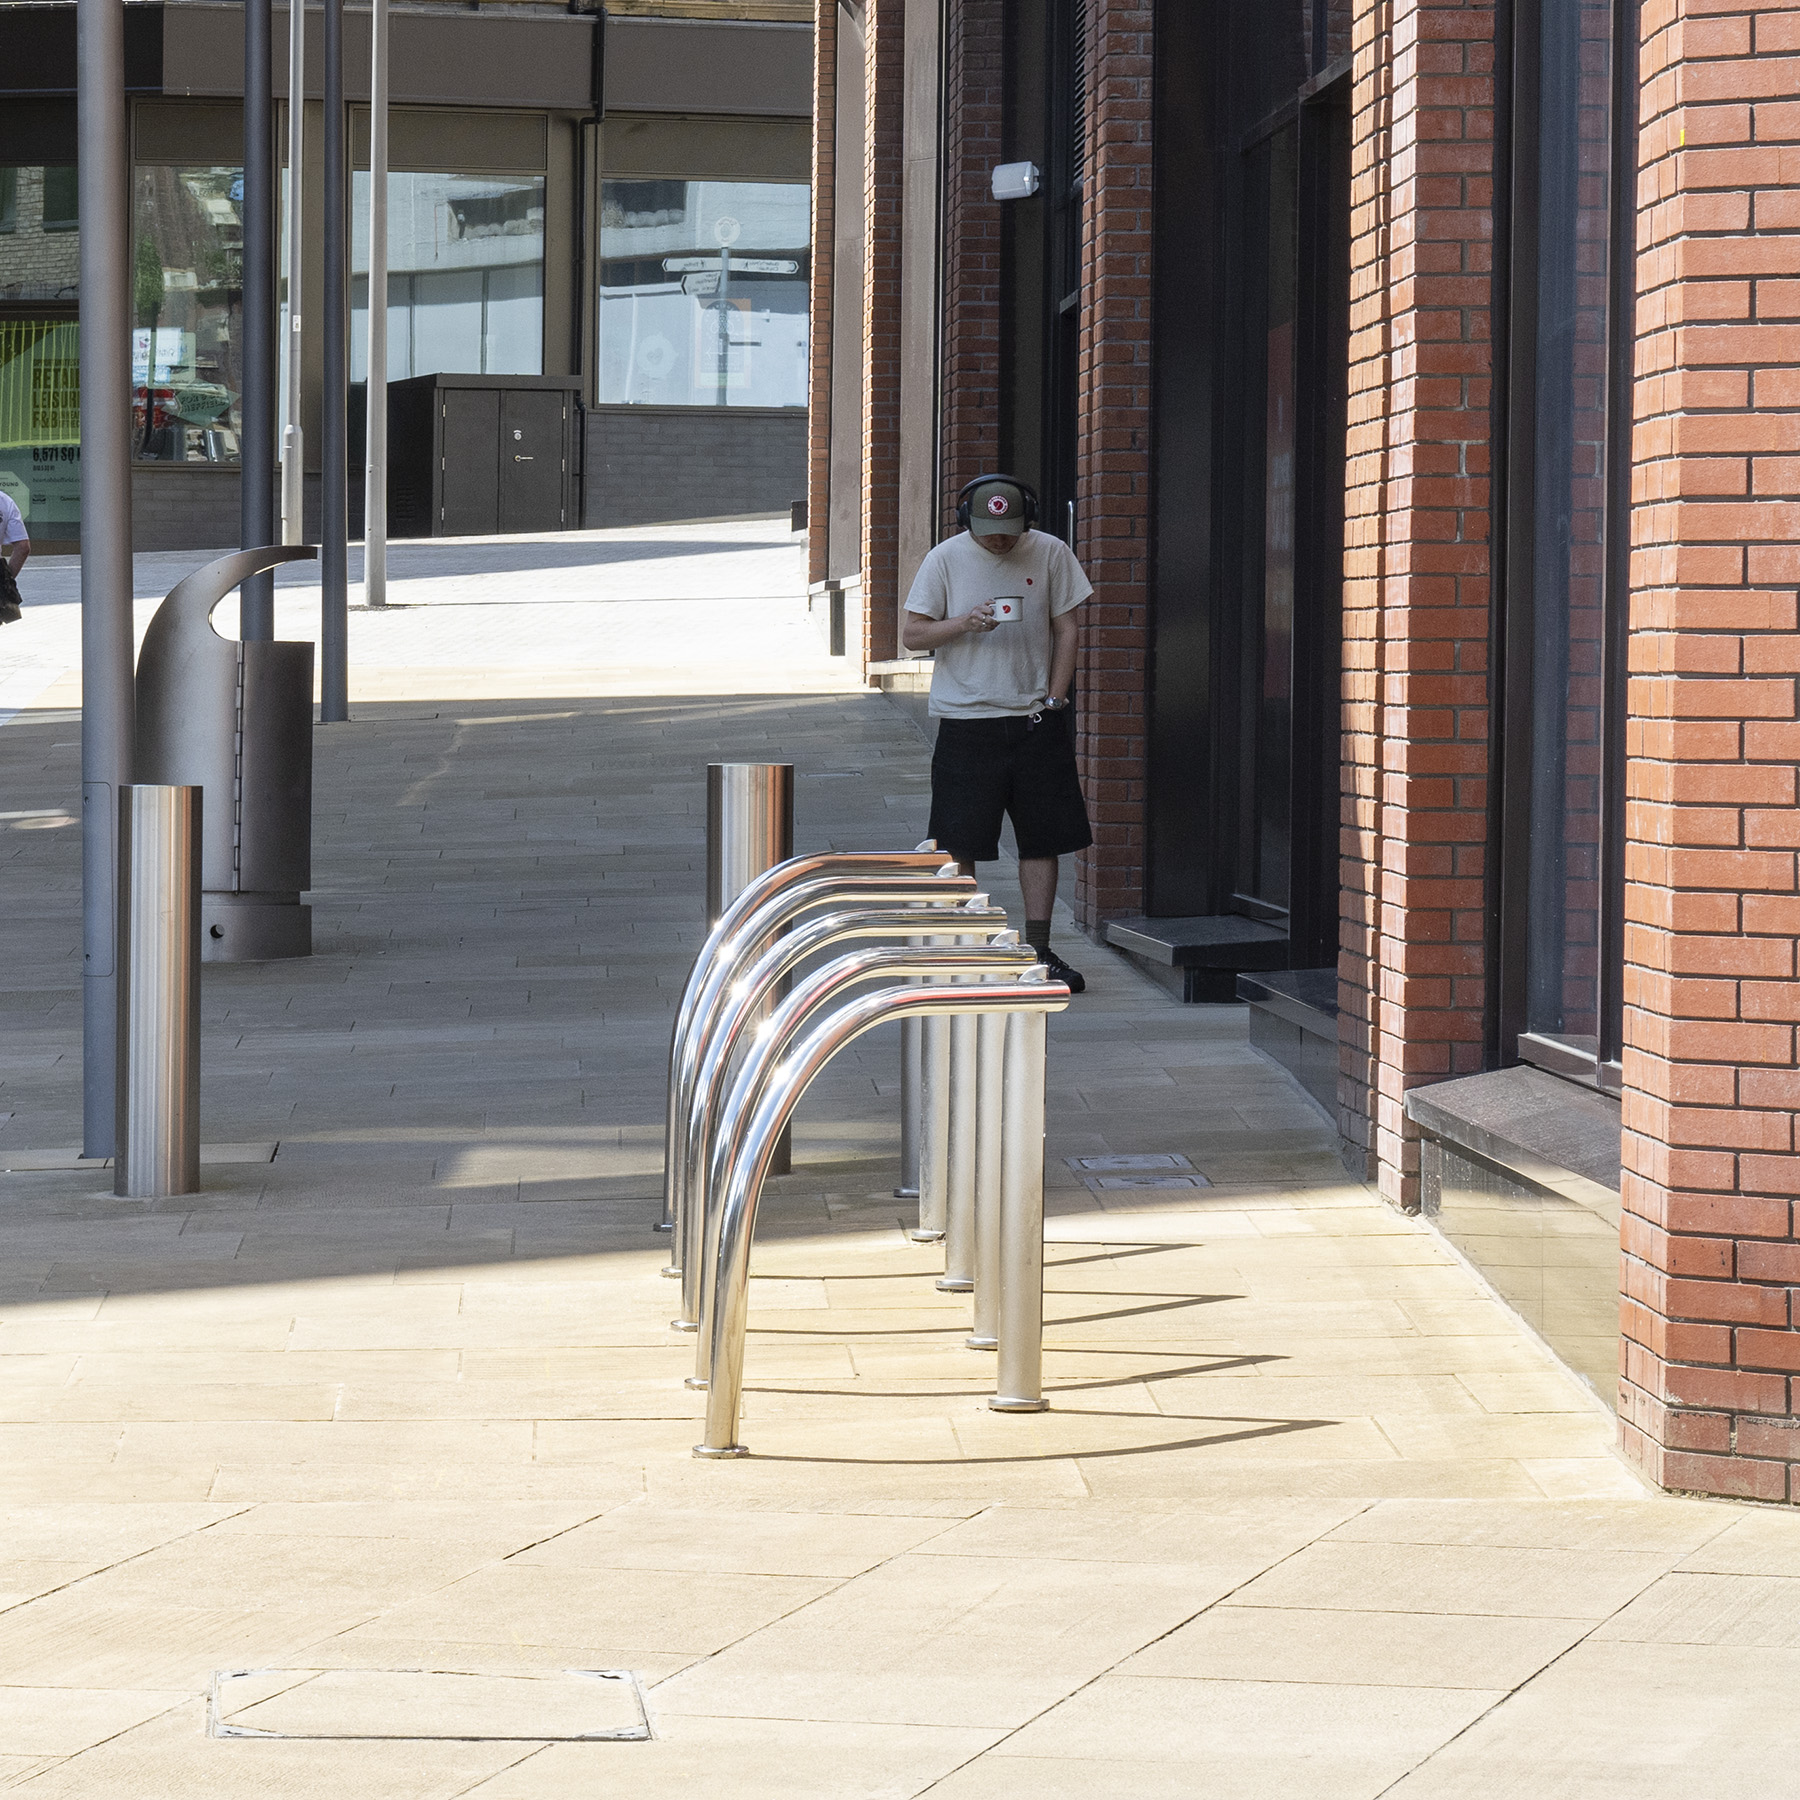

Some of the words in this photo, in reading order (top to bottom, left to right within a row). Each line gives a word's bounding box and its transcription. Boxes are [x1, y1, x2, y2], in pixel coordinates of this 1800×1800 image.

[33, 411, 58, 429] F&B
[32, 447, 59, 463] 6,571
[60, 447, 75, 464] SQ
